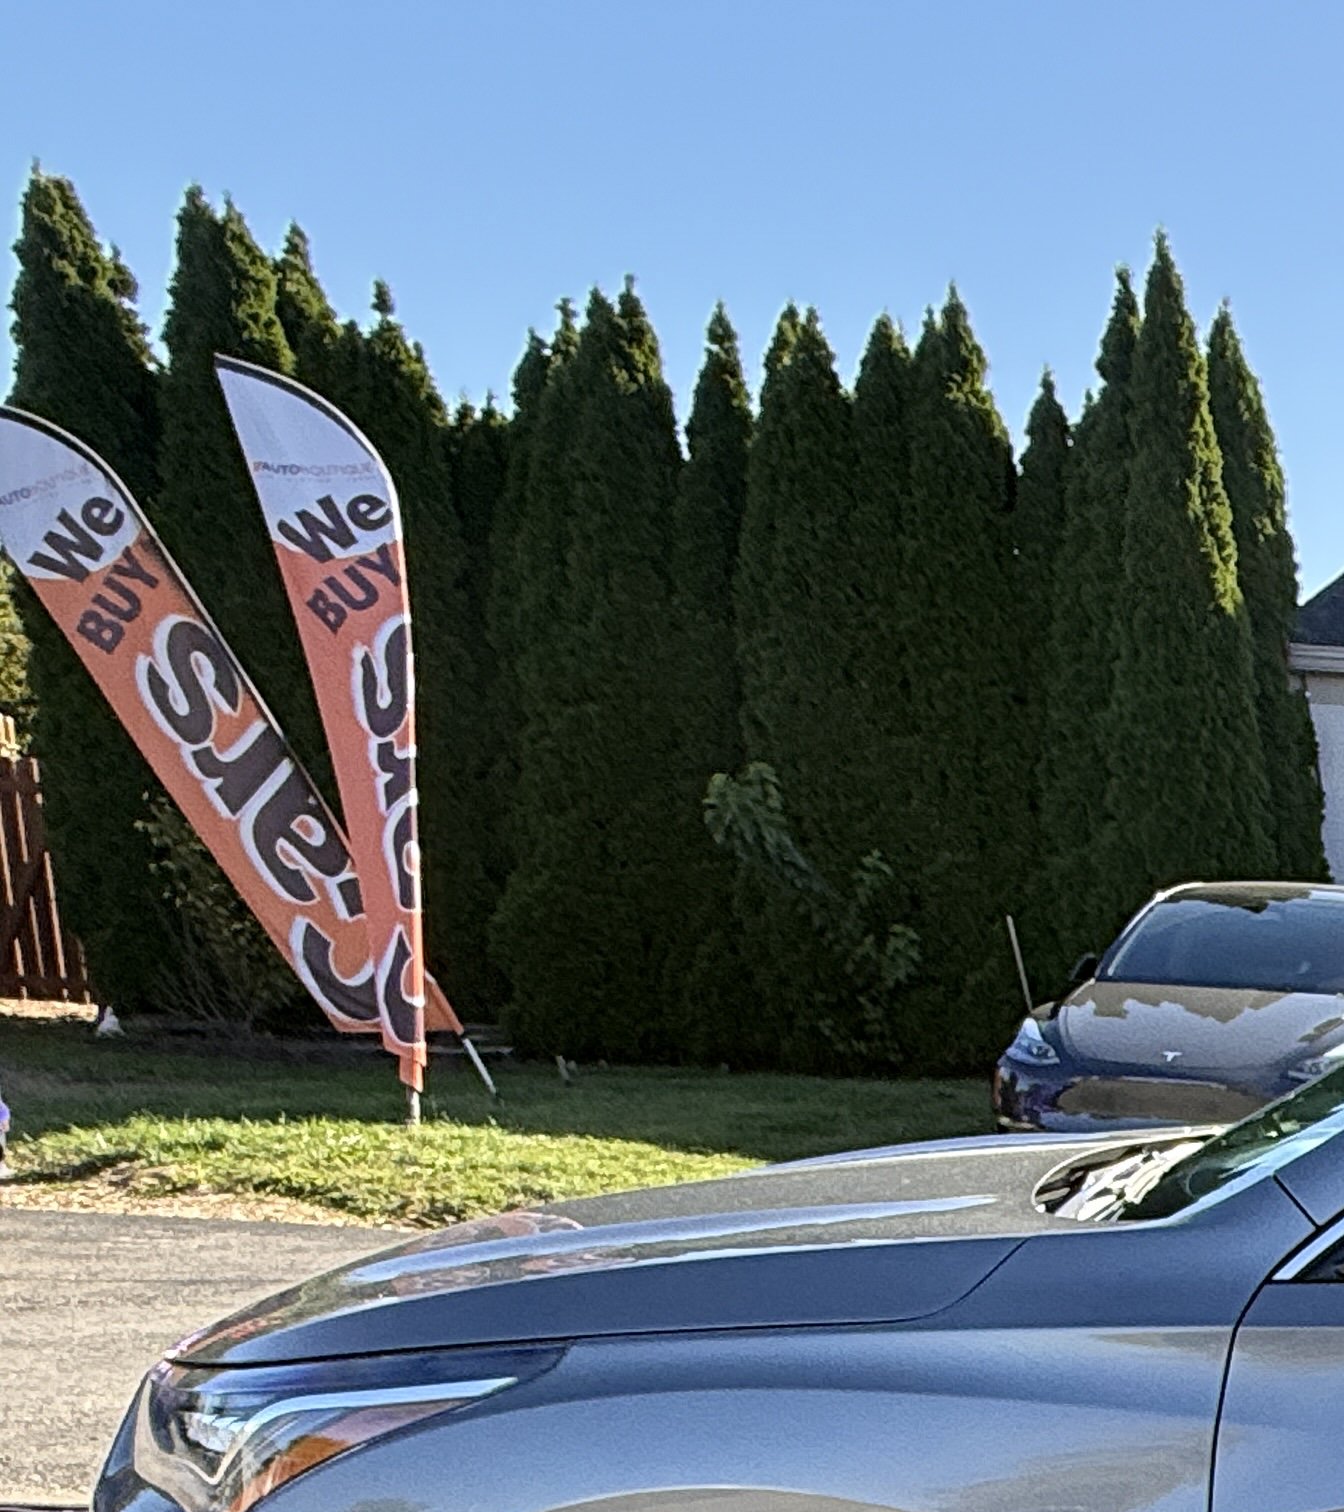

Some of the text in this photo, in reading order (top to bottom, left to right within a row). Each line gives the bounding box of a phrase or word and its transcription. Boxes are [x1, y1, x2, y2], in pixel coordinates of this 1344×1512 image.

[27, 496, 125, 583] We
[277, 494, 394, 563] We
[76, 546, 159, 655] BUY
[306, 543, 401, 635] BUY
